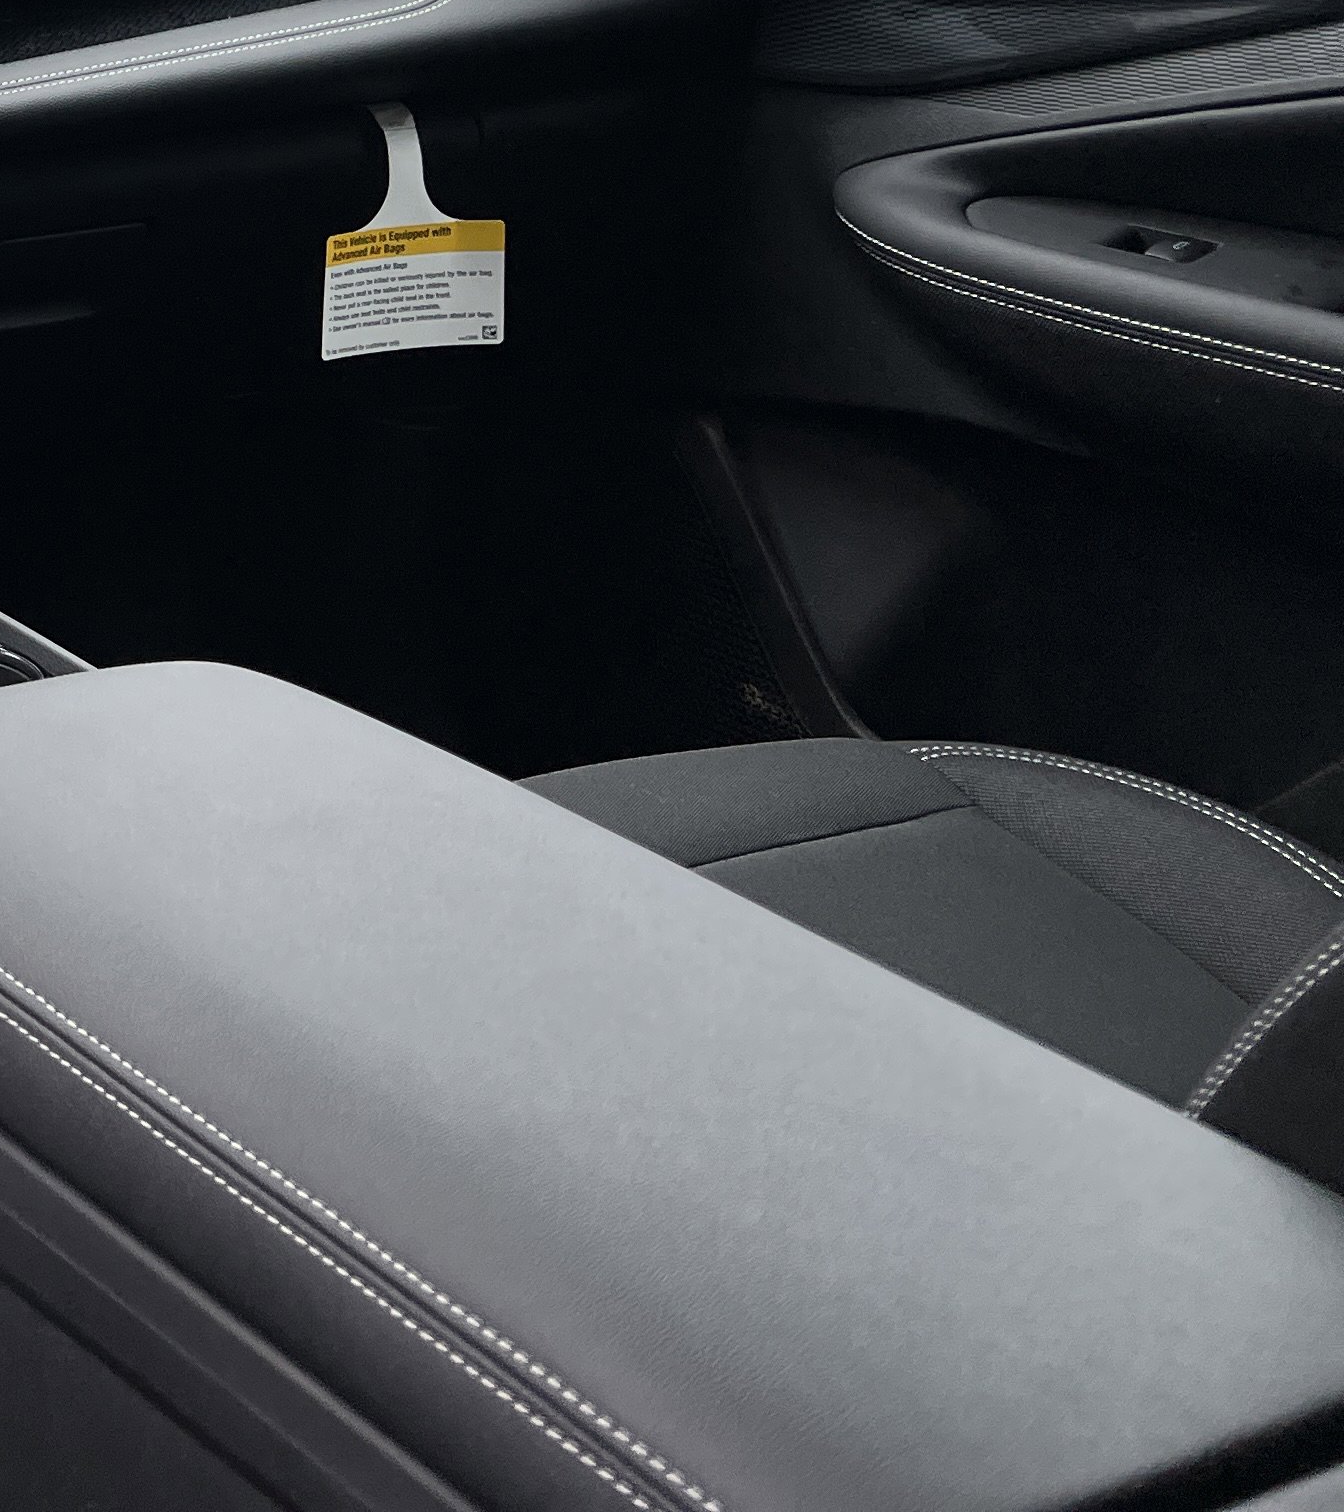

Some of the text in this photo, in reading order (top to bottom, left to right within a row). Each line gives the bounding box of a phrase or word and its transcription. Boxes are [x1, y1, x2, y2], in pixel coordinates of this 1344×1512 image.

[333, 227, 451, 250] This Vehicle is Equipped with
[332, 244, 405, 262] Advanced Air Bags
